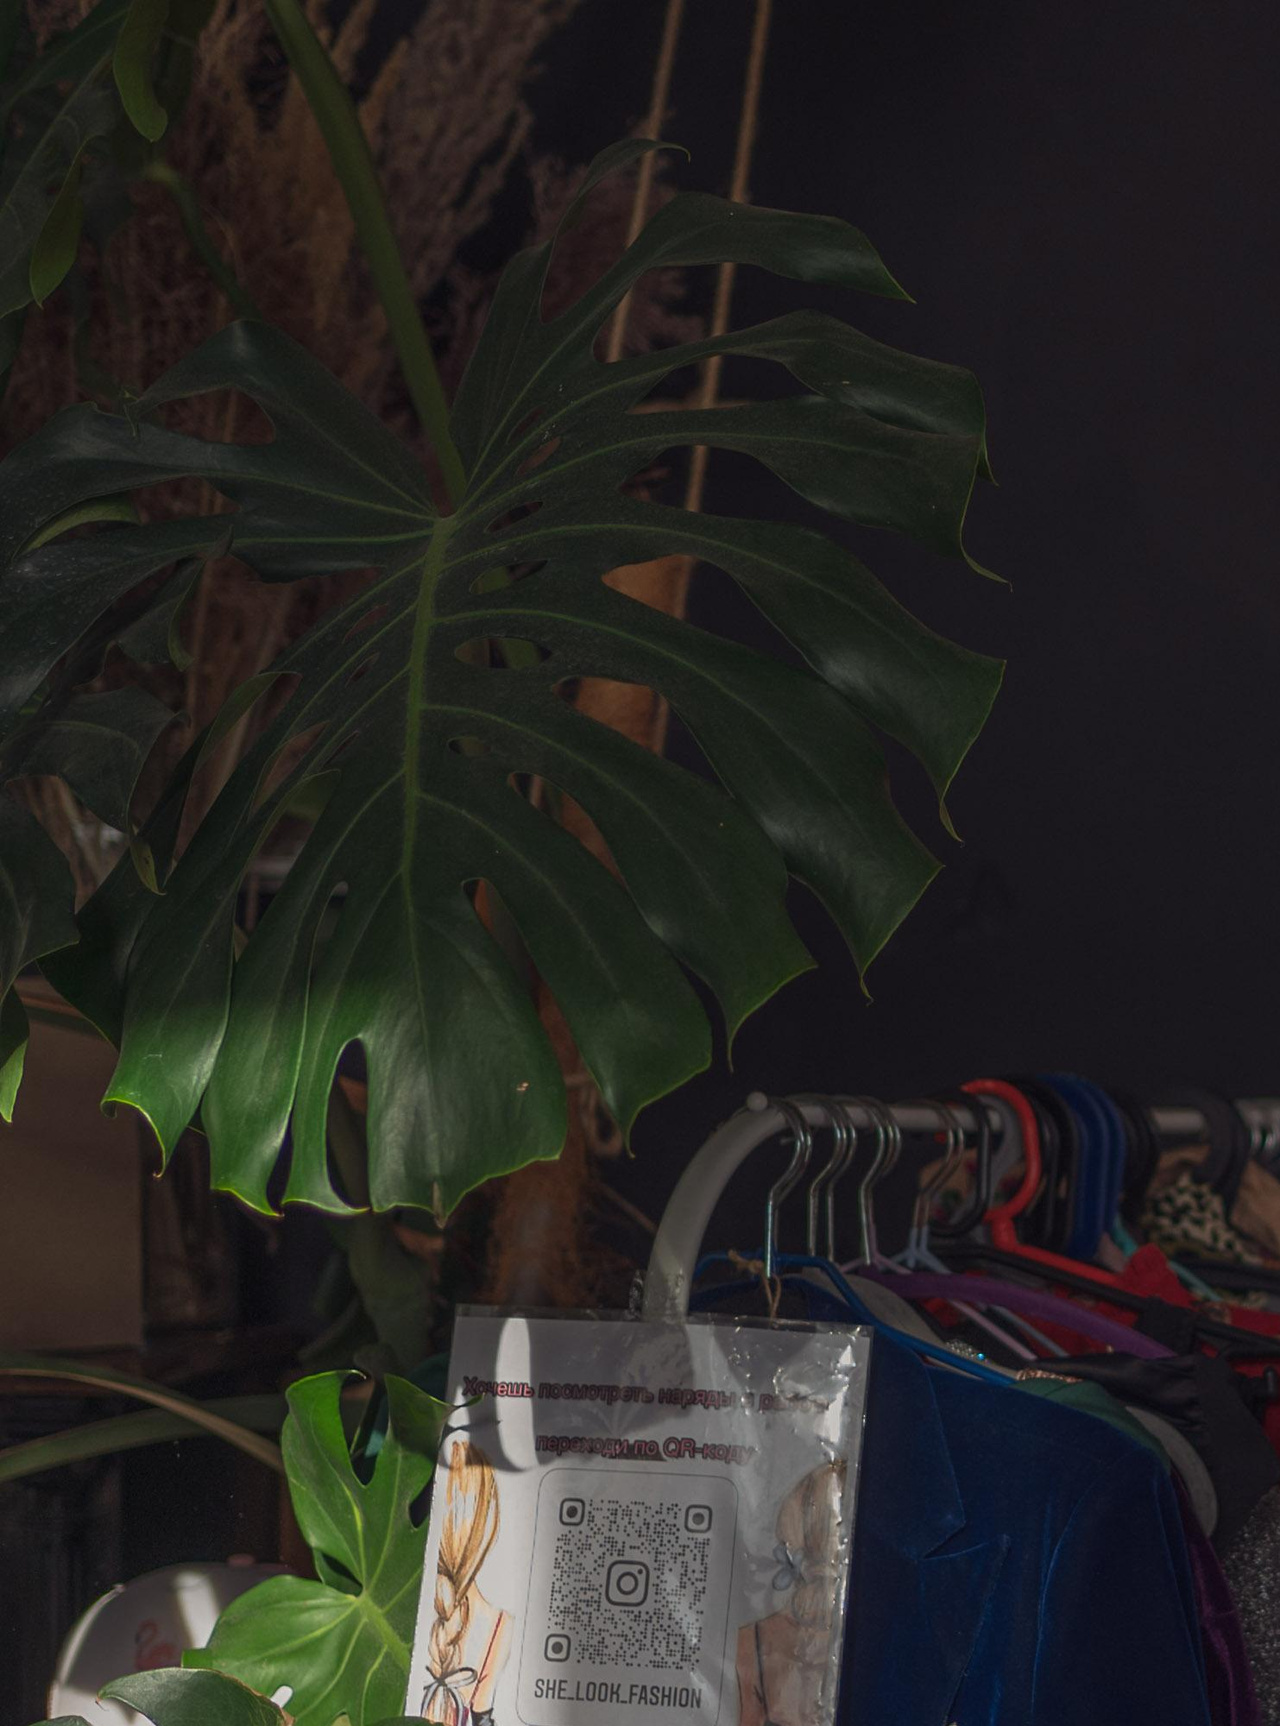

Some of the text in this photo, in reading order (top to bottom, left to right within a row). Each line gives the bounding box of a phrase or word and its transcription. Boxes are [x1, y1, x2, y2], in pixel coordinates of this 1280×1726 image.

[463, 1375, 535, 1397] Хочешь
[538, 1382, 655, 1405] посмотреть
[536, 1434, 754, 1465] переходи по QR-коду
[534, 1678, 702, 1709] SHE_LOOK_FASHION
